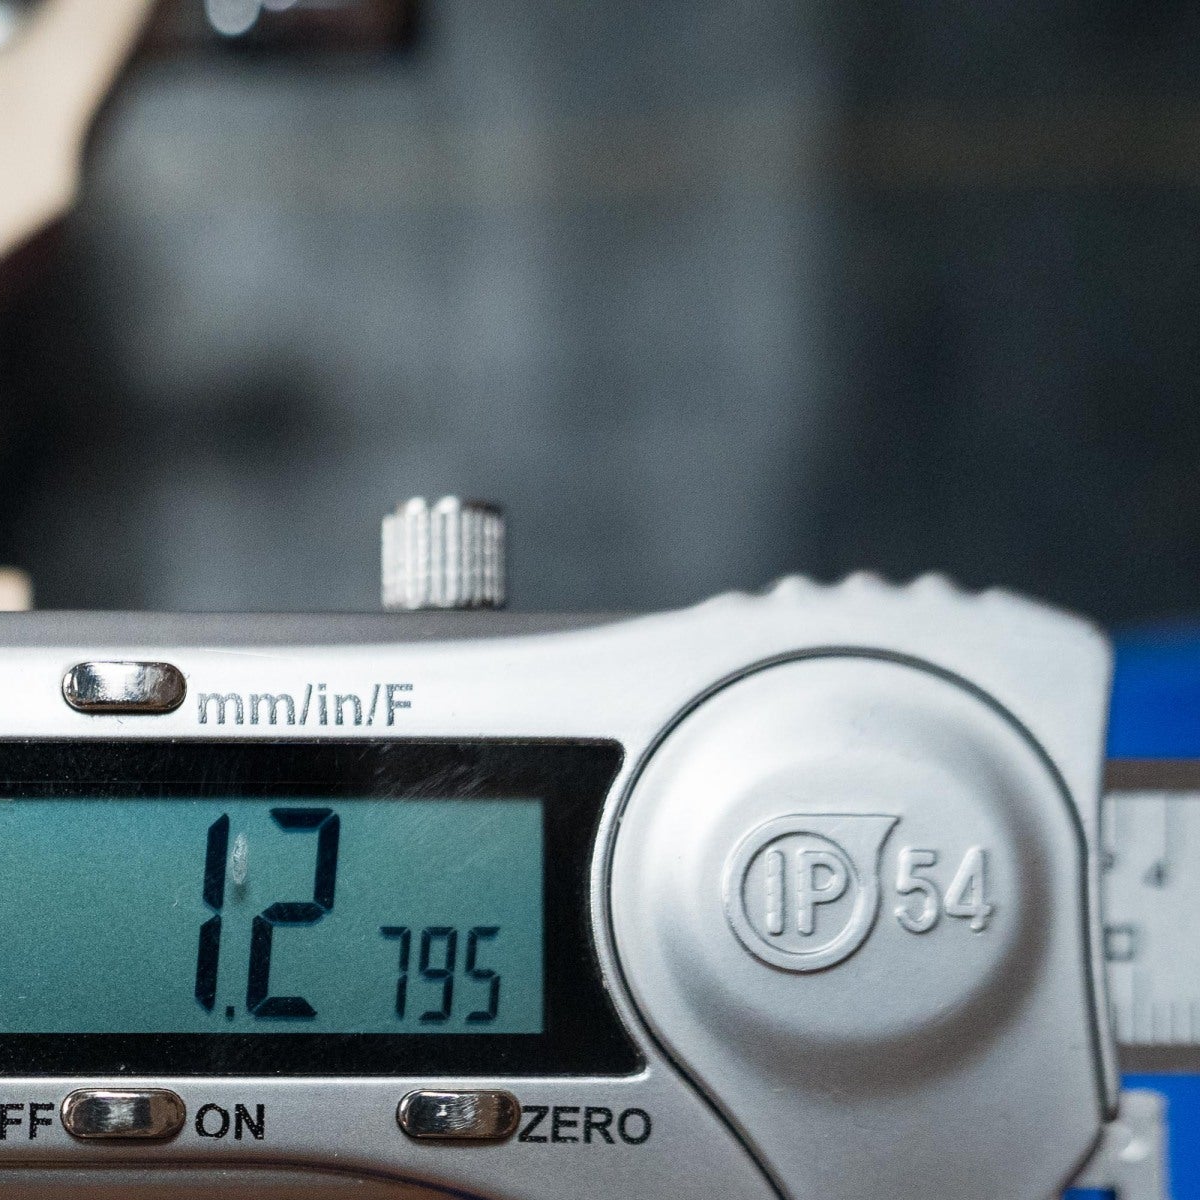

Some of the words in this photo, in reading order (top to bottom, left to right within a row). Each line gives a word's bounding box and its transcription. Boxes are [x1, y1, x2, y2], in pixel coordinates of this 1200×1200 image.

[197, 683, 414, 727] mm/in/F
[765, 848, 850, 937] IP
[894, 846, 996, 936] 54
[194, 1103, 266, 1142] ON
[517, 1105, 653, 1145] ZERO
